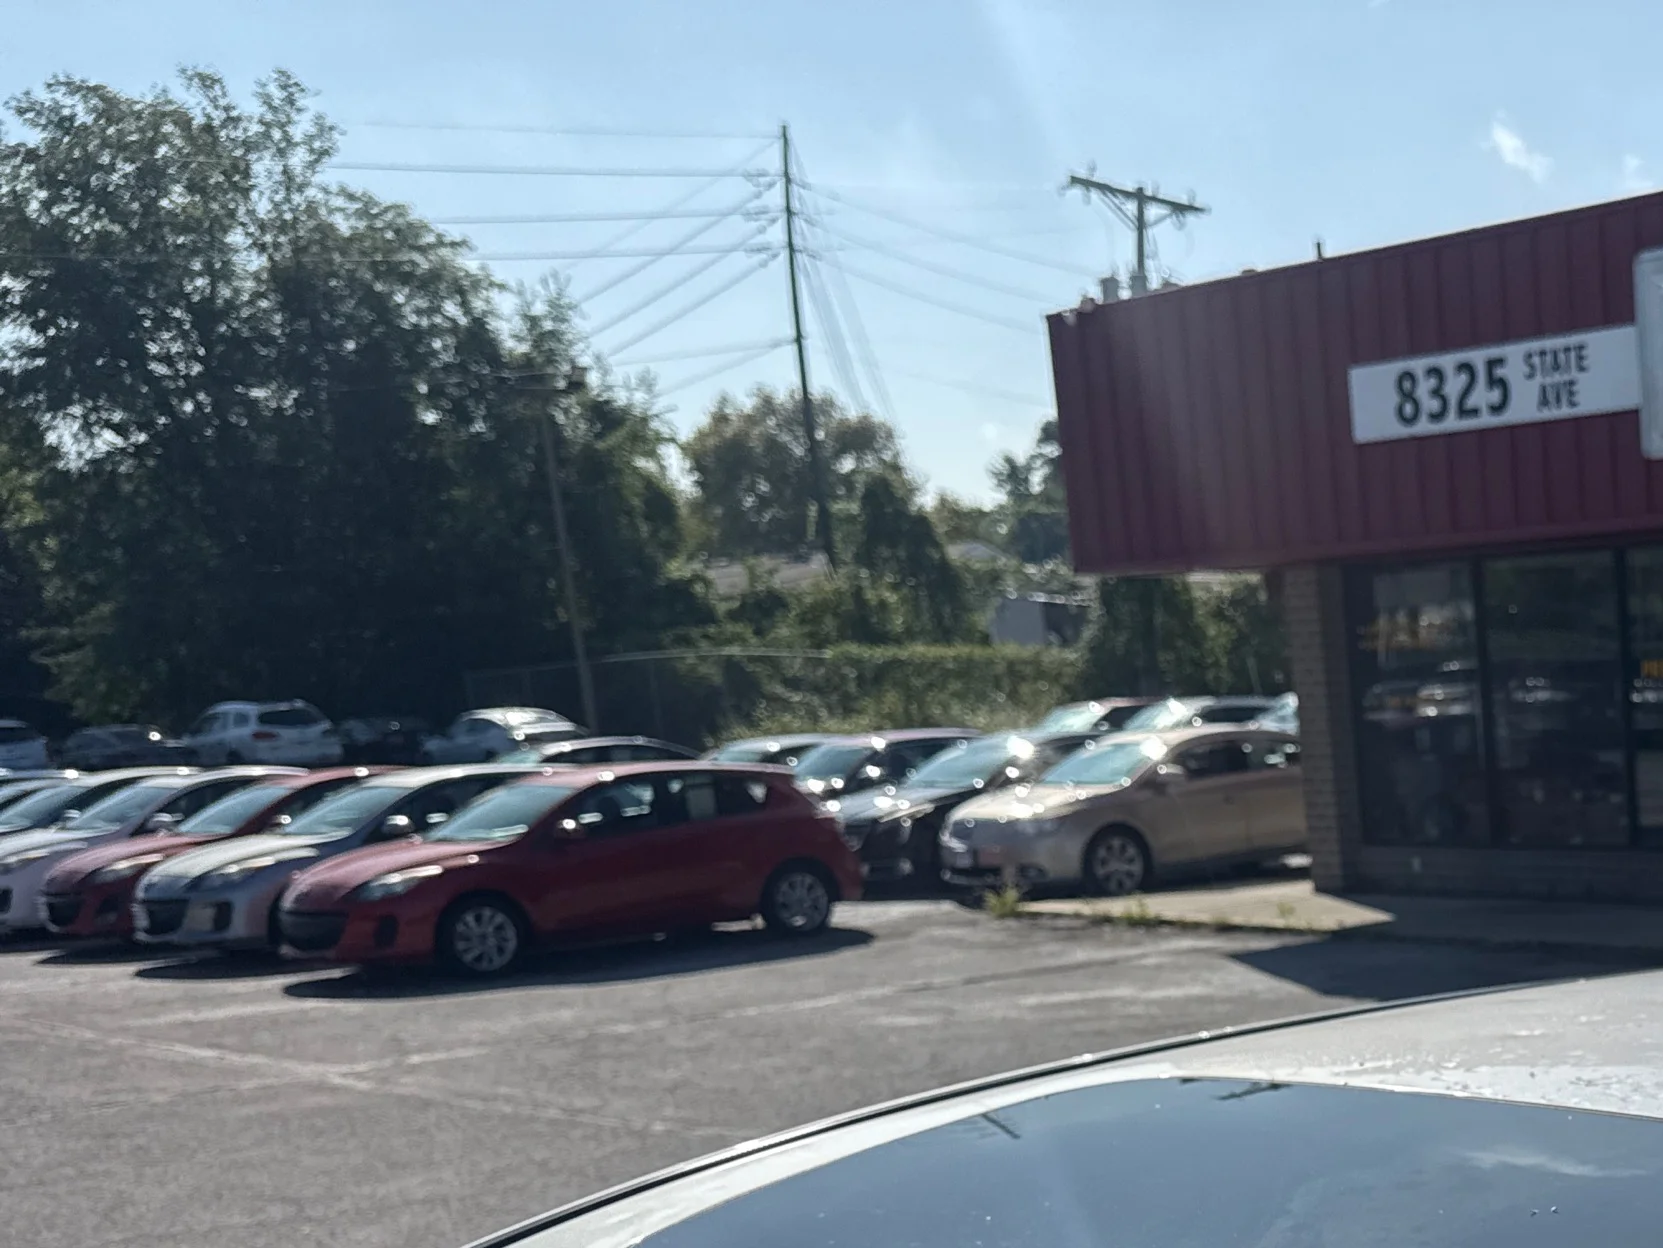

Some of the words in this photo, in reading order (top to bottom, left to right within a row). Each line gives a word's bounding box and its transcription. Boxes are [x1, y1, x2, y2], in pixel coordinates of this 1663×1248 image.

[1523, 343, 1589, 381] STATE
[1396, 357, 1510, 427] 8325
[1538, 379, 1579, 411] AVE
